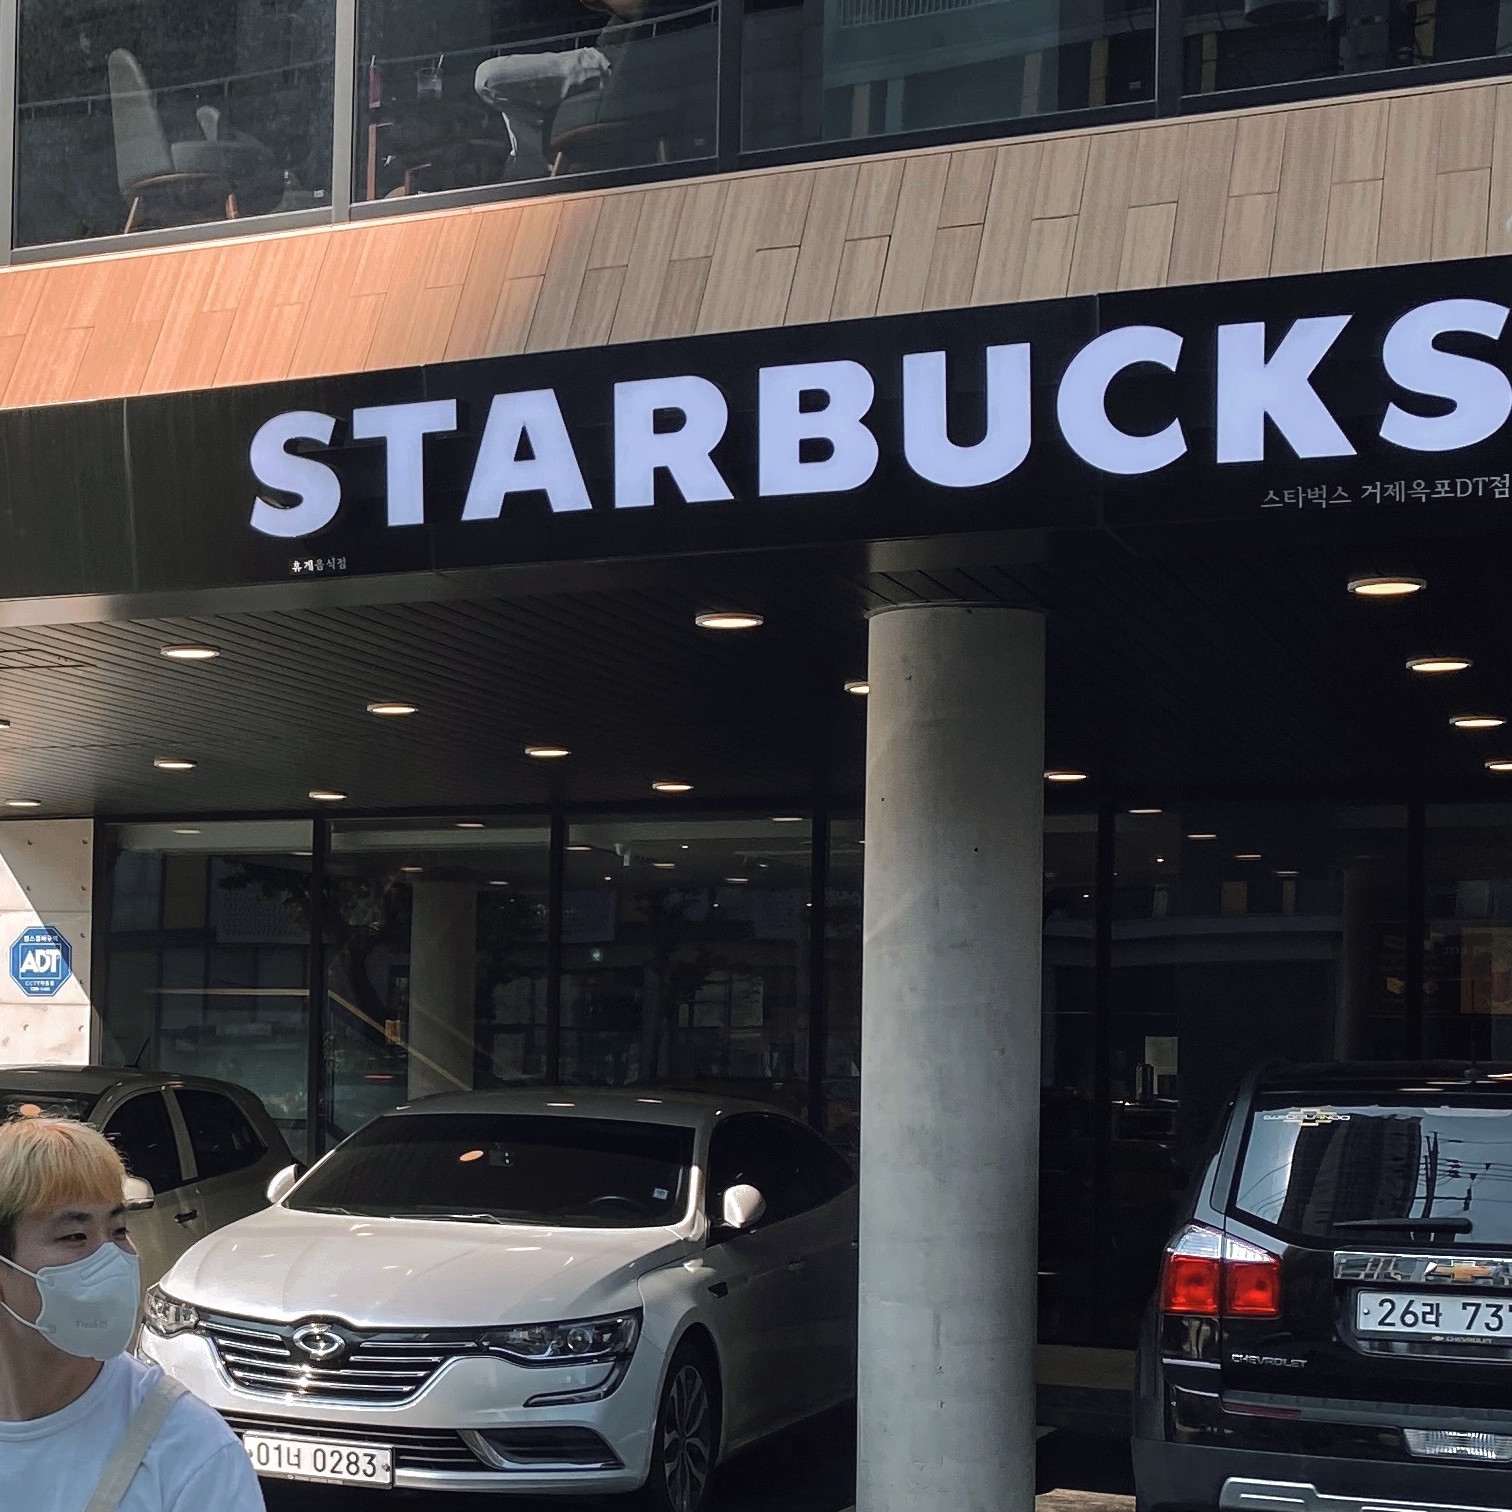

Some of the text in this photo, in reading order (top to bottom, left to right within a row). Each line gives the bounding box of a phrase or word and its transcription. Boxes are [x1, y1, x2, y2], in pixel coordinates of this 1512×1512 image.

[249, 298, 1512, 538] STARBUCKS
[1260, 473, 1510, 509] 스타벅스 거제옥포DT점
[291, 556, 347, 573] 휴게음식점
[20, 949, 62, 973] ADT
[1377, 1297, 1512, 1332] 26라 73
[1231, 1353, 1308, 1368] CHEVROLET
[256, 1442, 377, 1478] 01너 0283
